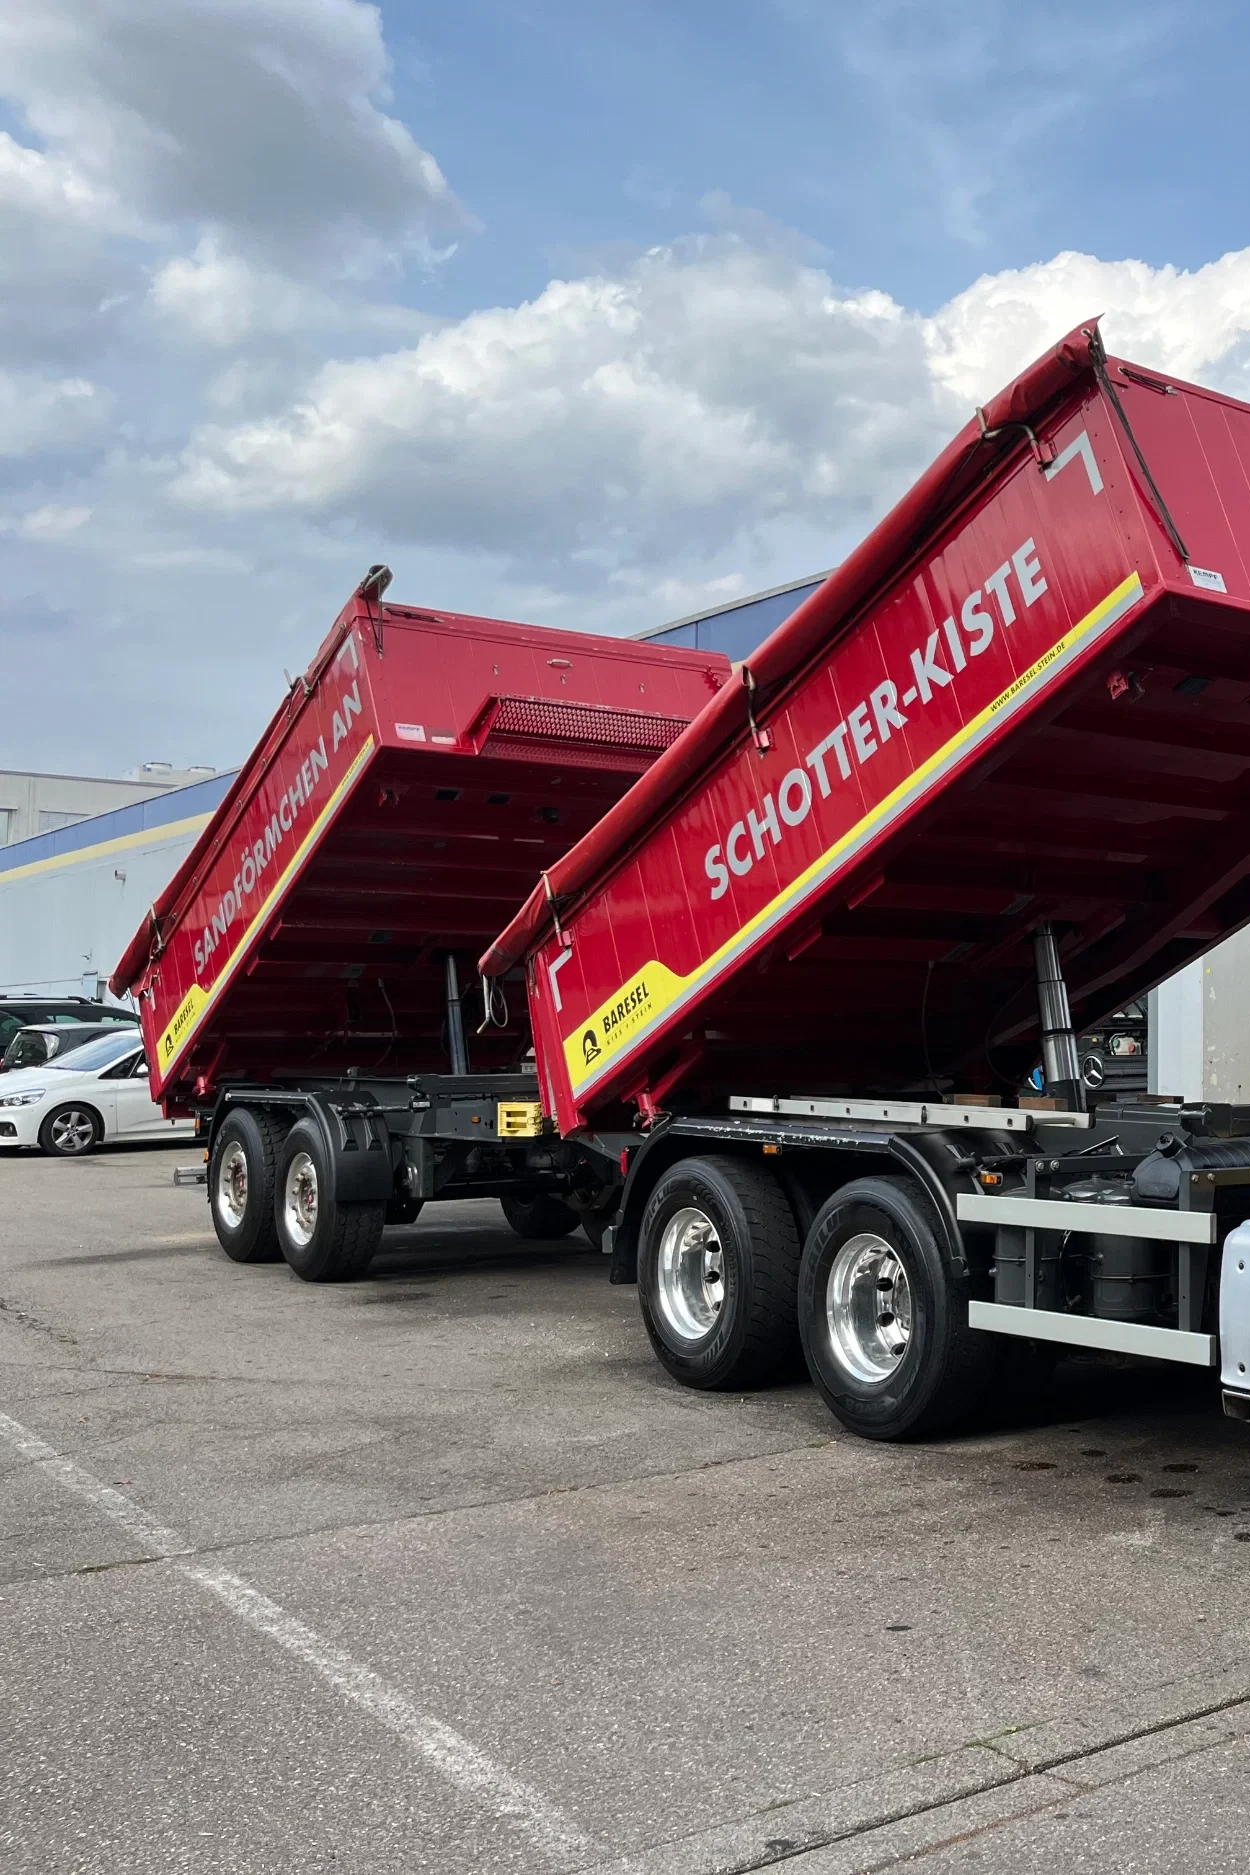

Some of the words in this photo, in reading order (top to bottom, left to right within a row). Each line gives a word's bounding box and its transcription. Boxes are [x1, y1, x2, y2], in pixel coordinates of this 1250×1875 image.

[989, 641, 1066, 713] WWW.BARESEL-STEIN.DE
[704, 537, 1049, 900] SCHOTTER-KISTE
[193, 735, 329, 975] SANDFÖRMCHEN
[332, 680, 363, 753] AN
[174, 998, 194, 1035] BARESEL
[602, 981, 650, 1035] BARESEL
[631, 1002, 652, 1024] STEIN
